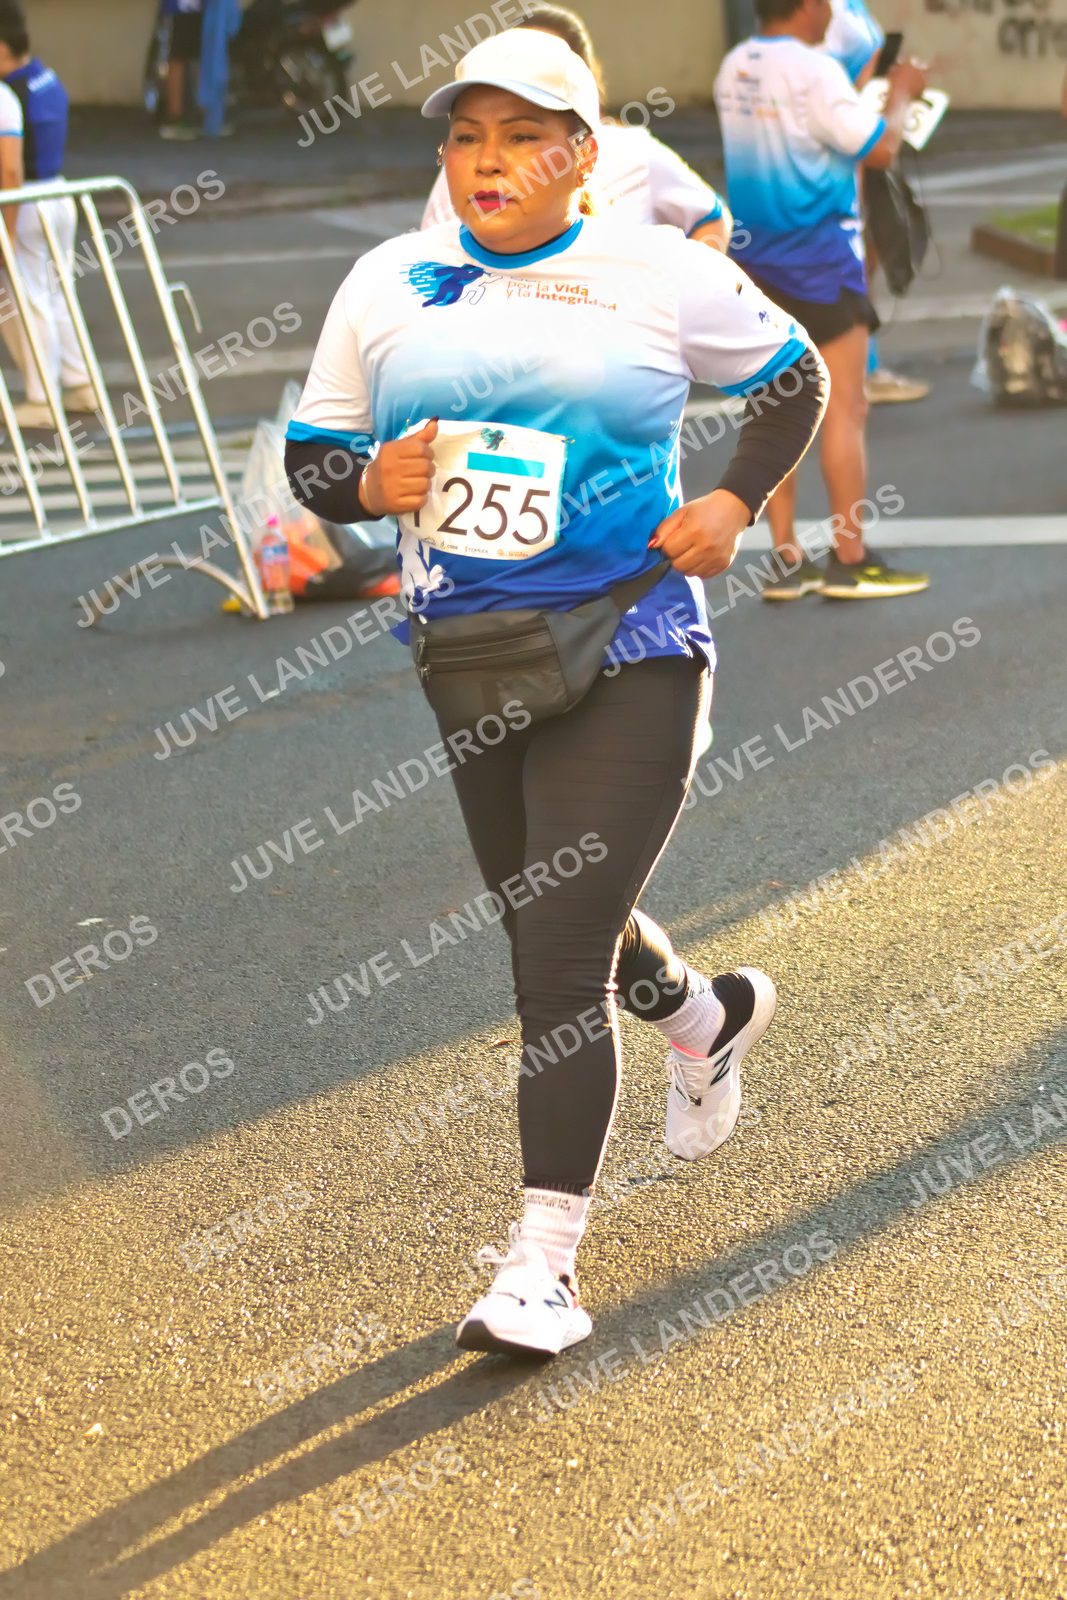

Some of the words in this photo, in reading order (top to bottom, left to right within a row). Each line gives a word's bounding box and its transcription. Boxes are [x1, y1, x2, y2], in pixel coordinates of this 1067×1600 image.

[507, 280, 534, 290] por
[554, 284, 589, 297] Vida
[517, 288, 531, 299] la
